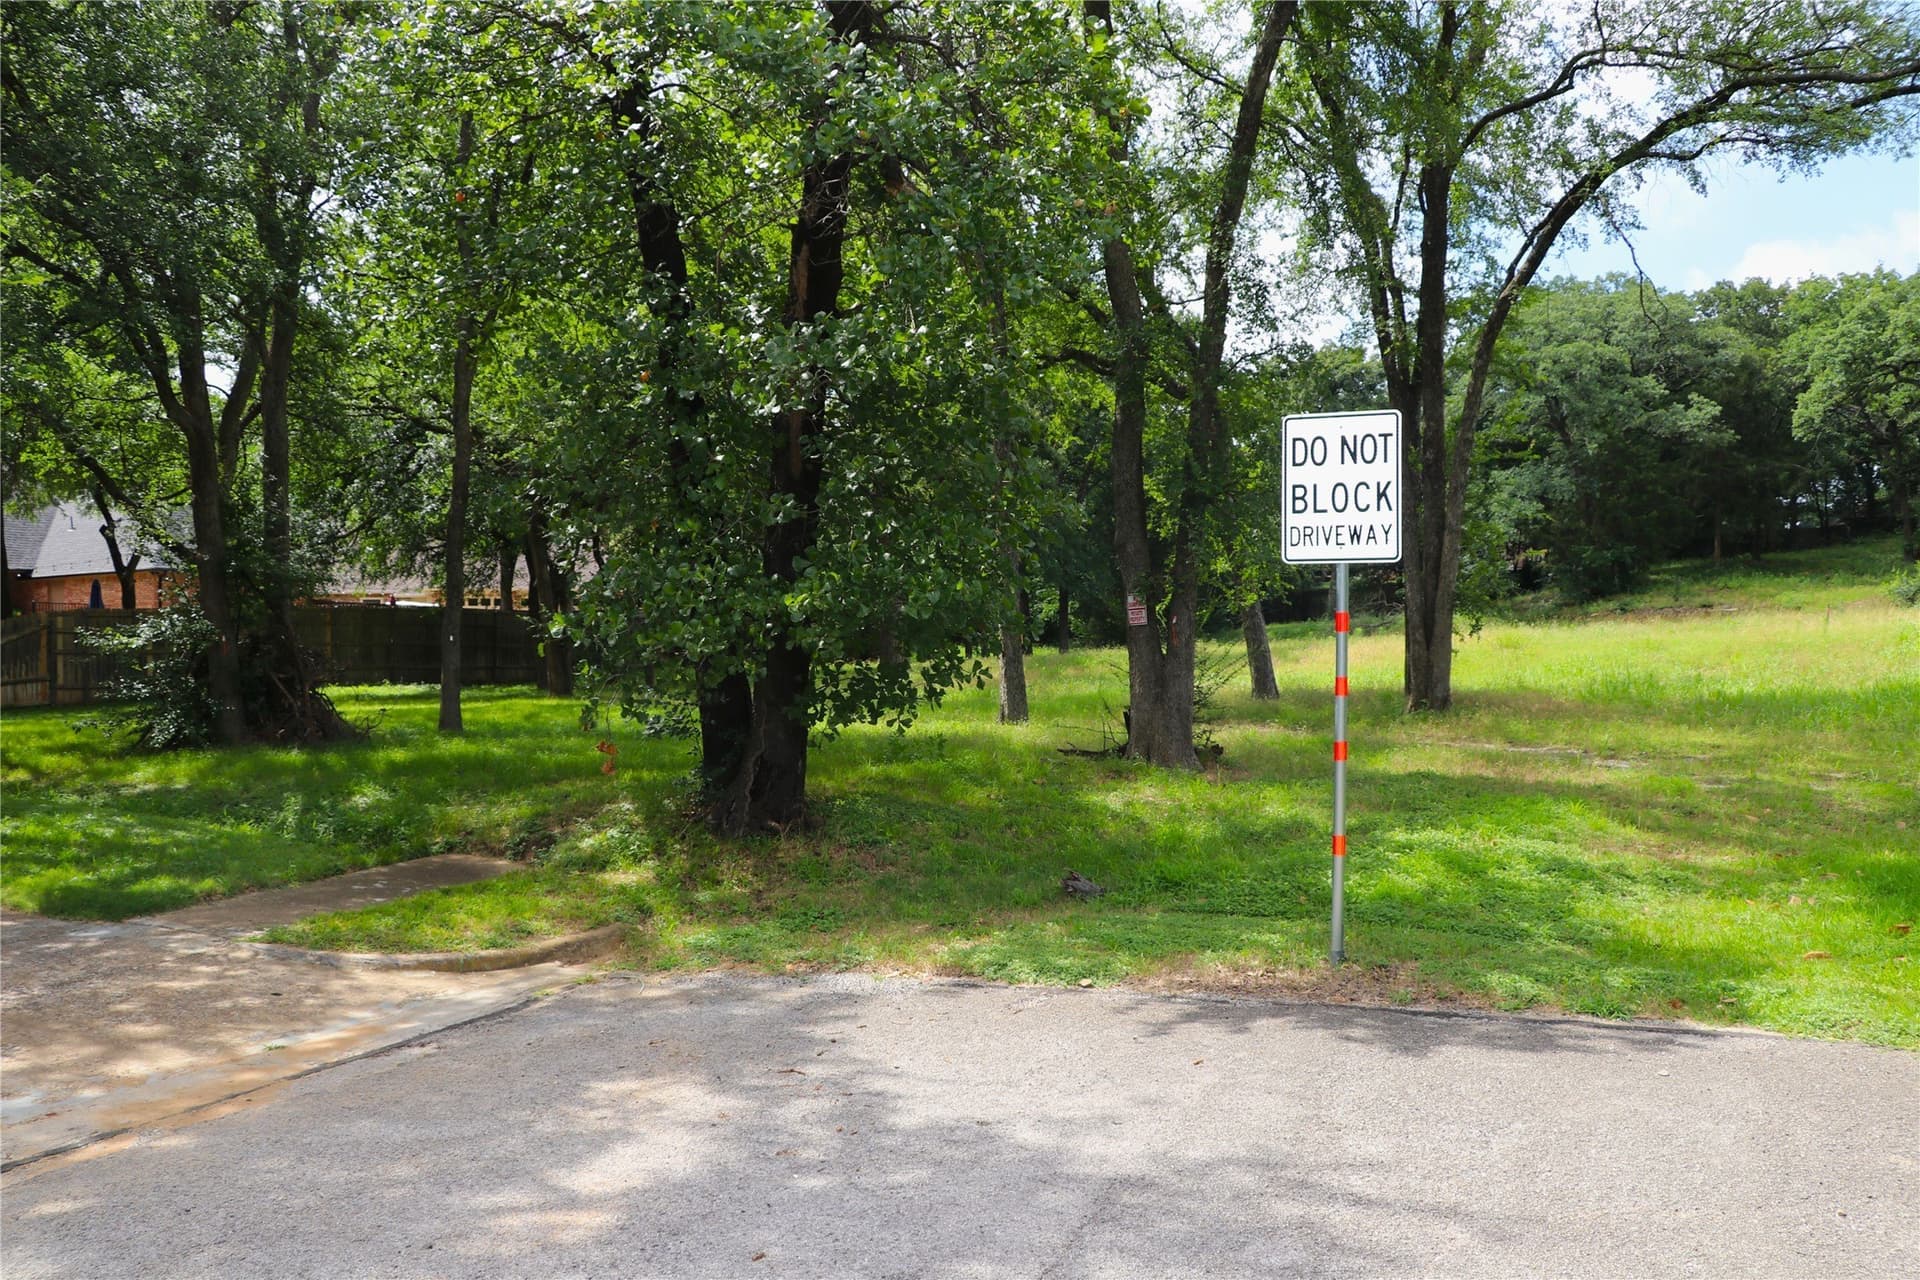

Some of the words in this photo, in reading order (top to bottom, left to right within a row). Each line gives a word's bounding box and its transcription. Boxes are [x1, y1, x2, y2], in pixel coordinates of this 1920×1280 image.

[1292, 436, 1327, 467] DO
[1340, 433, 1393, 465] NOT
[1292, 481, 1393, 514] BLOCK
[1290, 524, 1392, 547] DRIVEWAY
